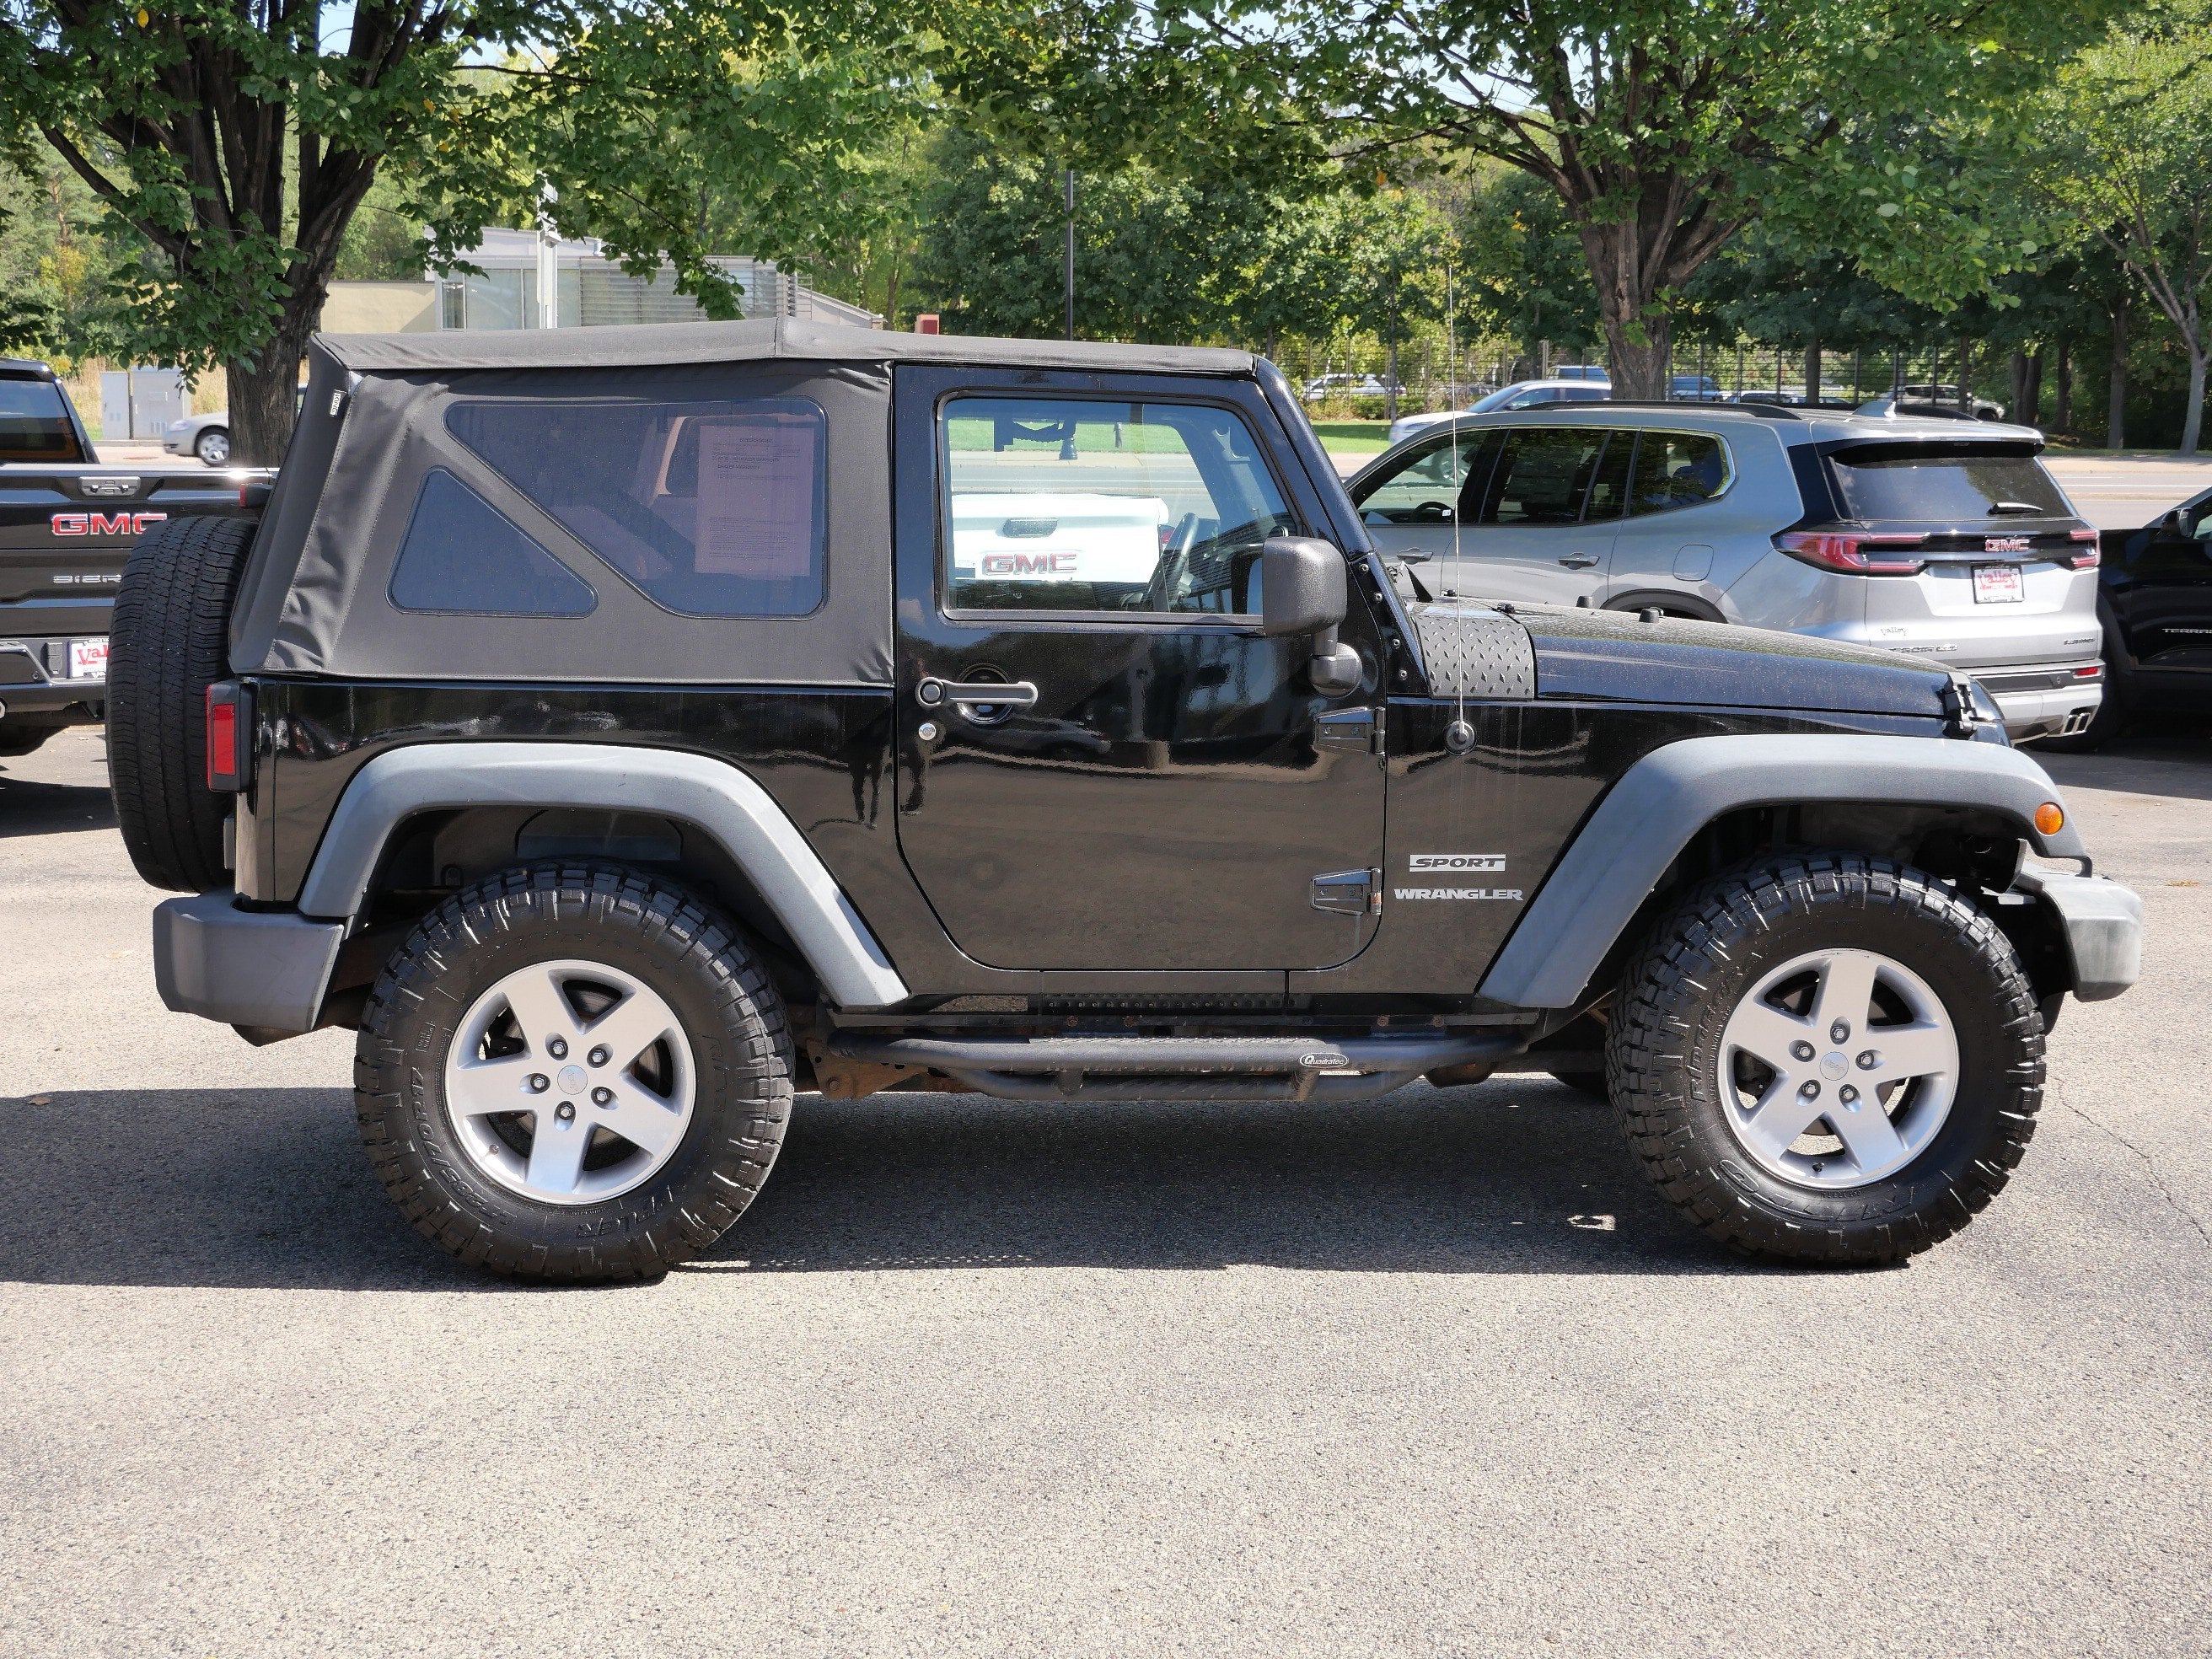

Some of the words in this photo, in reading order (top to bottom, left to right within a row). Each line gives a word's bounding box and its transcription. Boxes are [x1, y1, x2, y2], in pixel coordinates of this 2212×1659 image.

[51, 513, 168, 535] GMC
[1984, 539, 2030, 552] GMC
[982, 553, 1077, 576] GMC
[52, 574, 121, 583] SIER
[77, 644, 109, 666] Val
[1410, 858, 1505, 869] SPORT
[1394, 889, 1524, 901] WRANGLER
